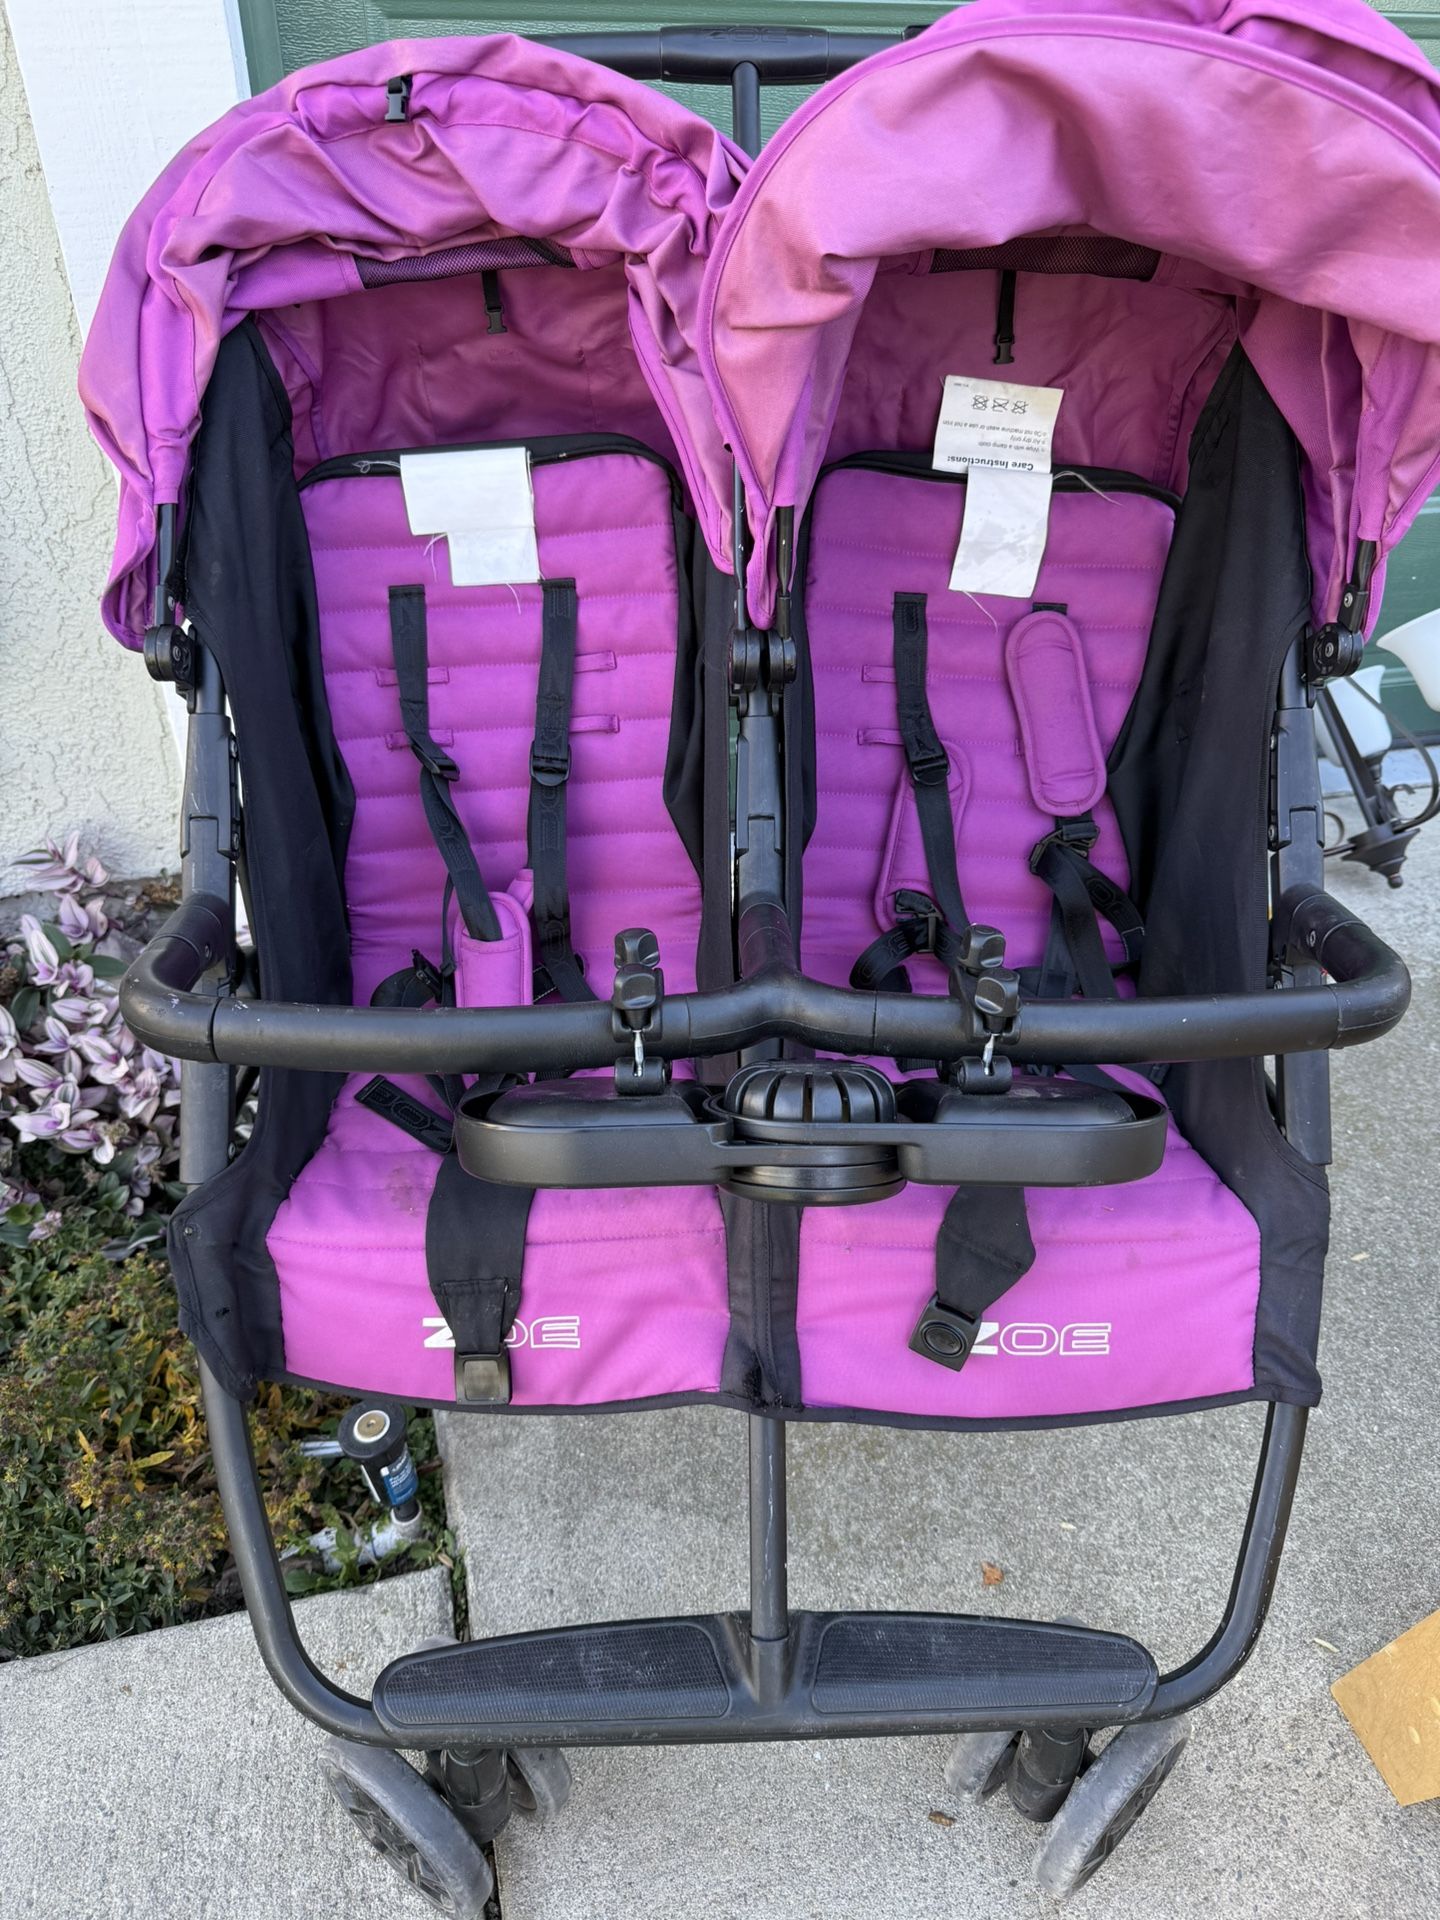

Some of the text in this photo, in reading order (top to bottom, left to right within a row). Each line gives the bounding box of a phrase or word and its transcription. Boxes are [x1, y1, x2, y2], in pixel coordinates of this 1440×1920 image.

[703, 28, 788, 44] ZOE
[1001, 426, 1023, 434] machine
[1010, 434, 1022, 442] only
[1023, 436, 1031, 444] dry
[993, 441, 1008, 450] damp
[1026, 445, 1040, 453] Wipe
[947, 456, 1034, 471] Care Instructions:
